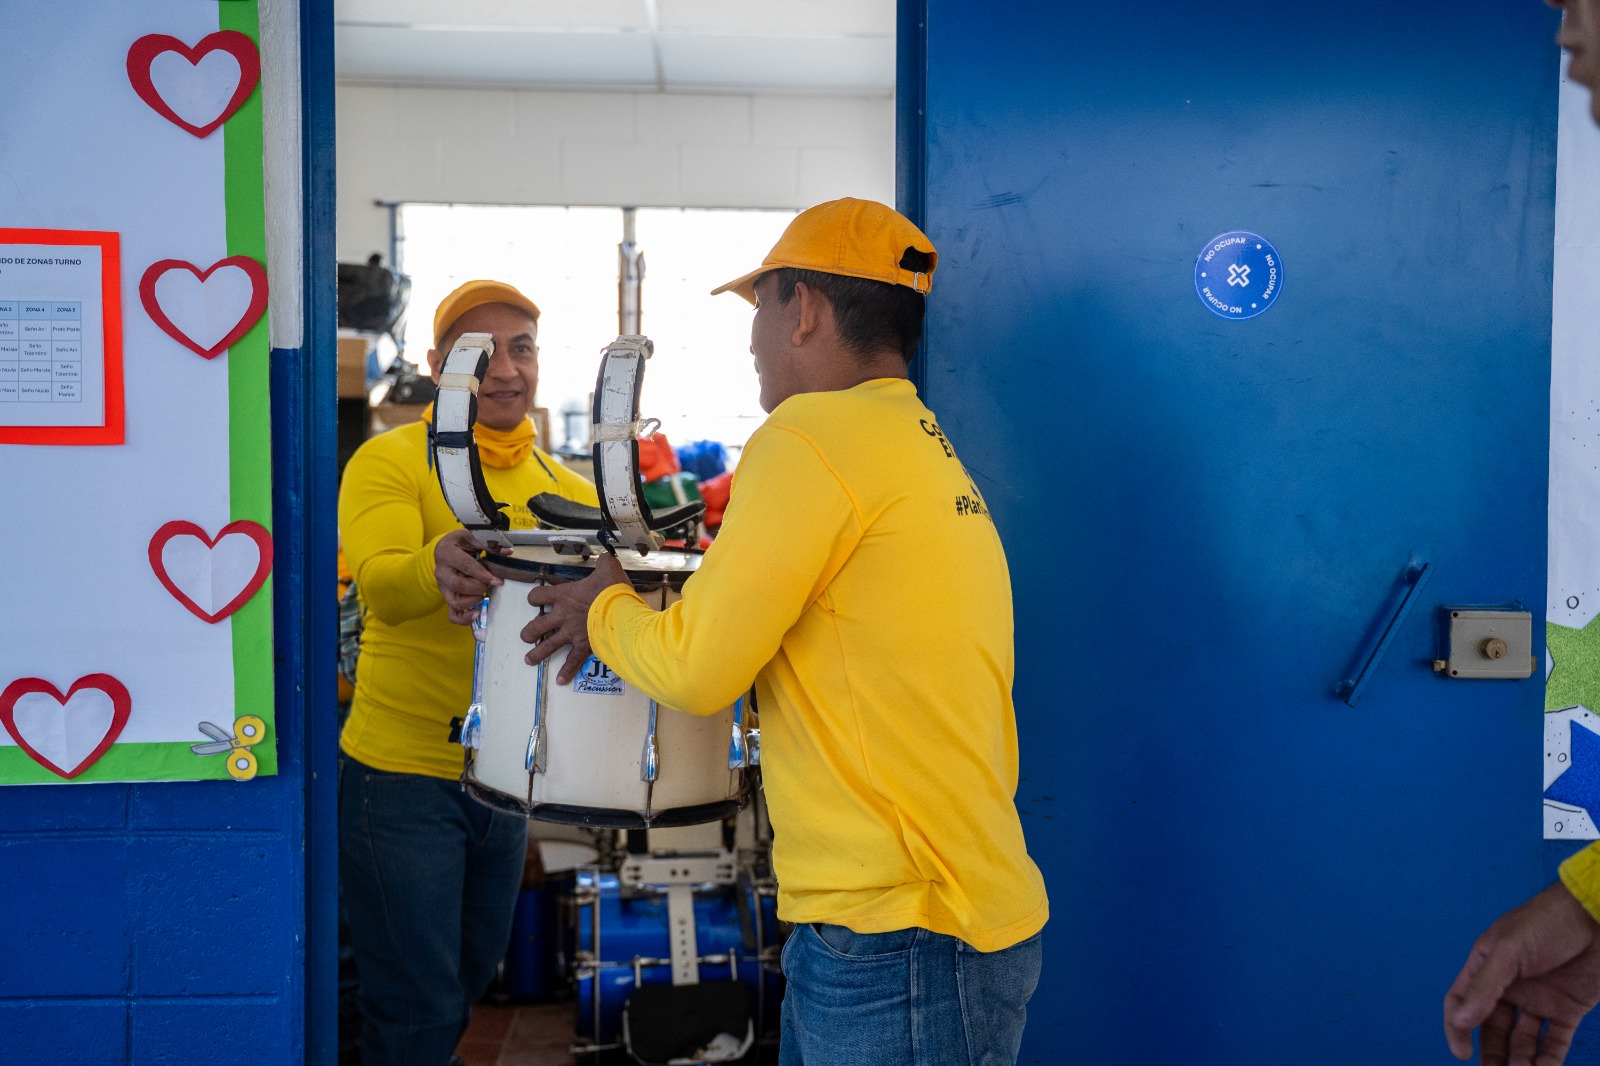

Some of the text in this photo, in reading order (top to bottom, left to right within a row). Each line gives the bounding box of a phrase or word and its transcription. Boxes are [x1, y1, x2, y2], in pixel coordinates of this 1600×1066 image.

[14, 257, 25, 265] DE
[55, 258, 82, 266] TURNO
[1204, 237, 1246, 262] NO OCUPAR
[1262, 254, 1277, 300] NO OCUPAR
[1202, 287, 1242, 314] NO OCUPAR
